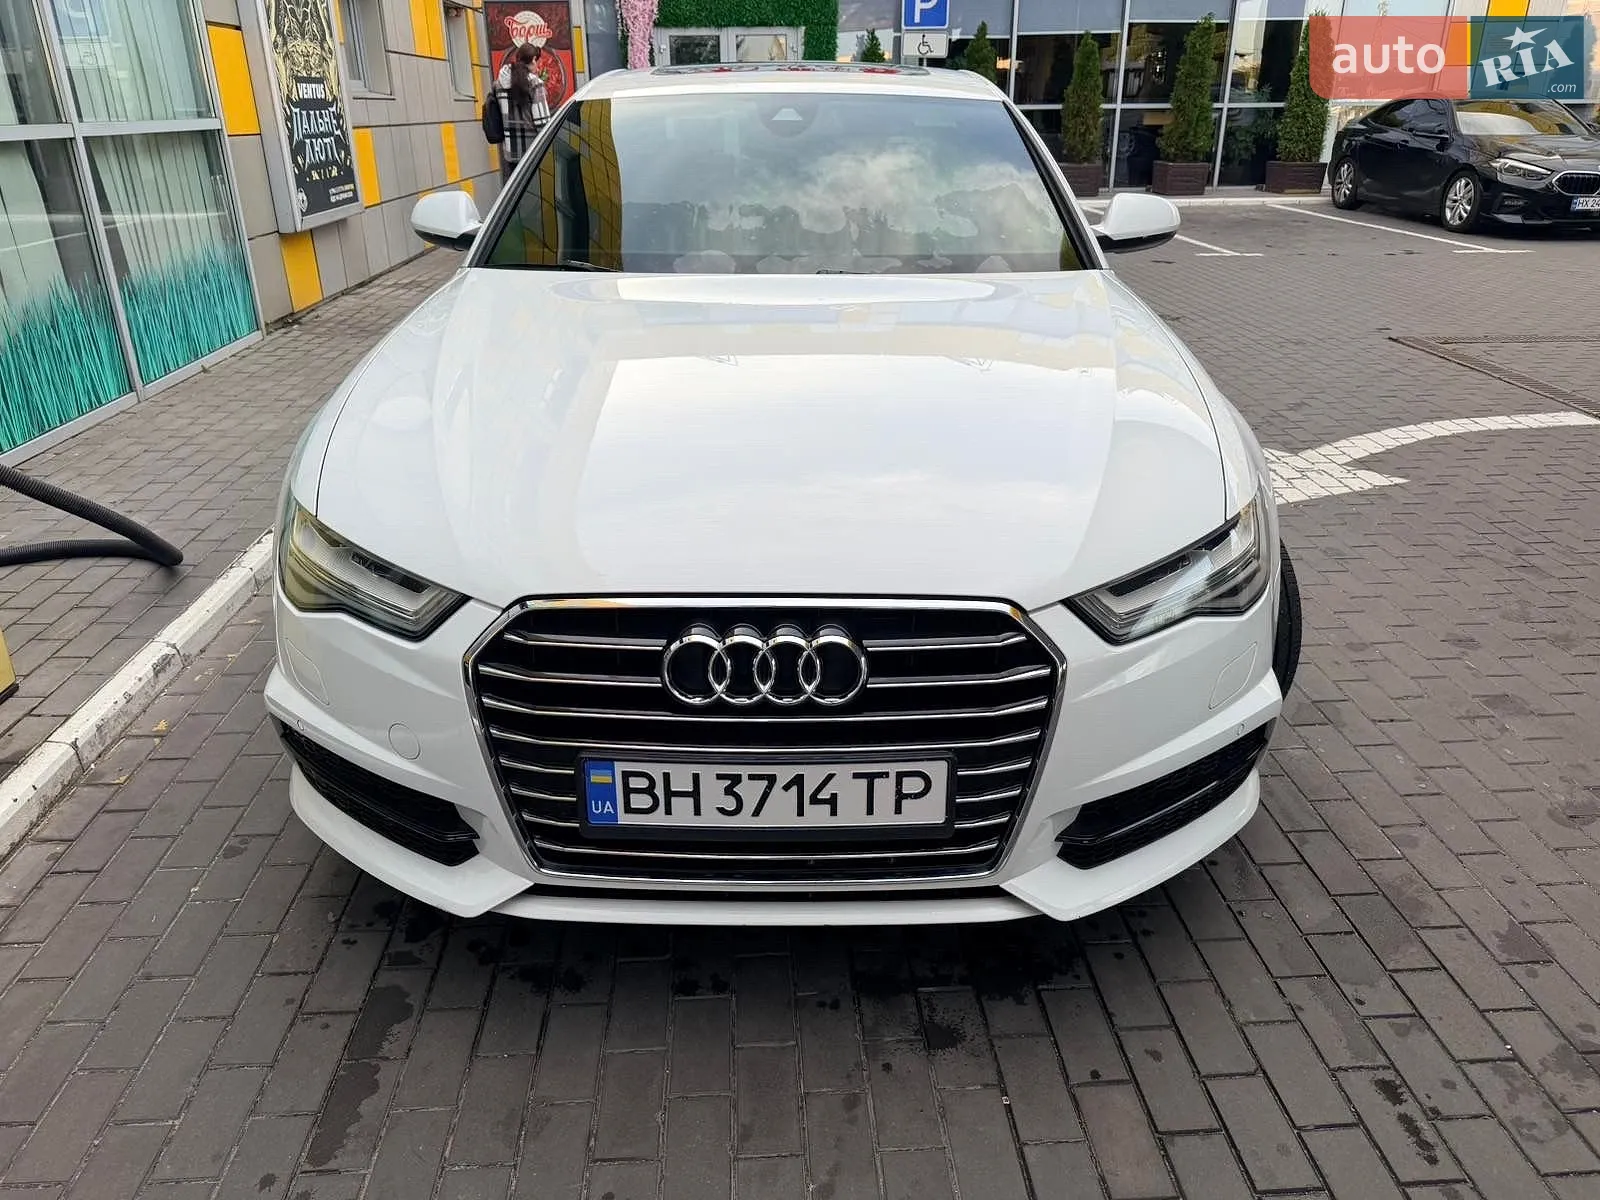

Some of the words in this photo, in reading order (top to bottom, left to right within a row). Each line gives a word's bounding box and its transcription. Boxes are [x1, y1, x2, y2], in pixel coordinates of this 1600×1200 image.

[297, 83, 325, 99] VENTUS
[290, 103, 343, 144] ПАЛЬНЕ
[621, 769, 701, 816] BH
[715, 772, 838, 817] 3714
[852, 769, 933, 816] TP
[591, 801, 615, 815] UA
